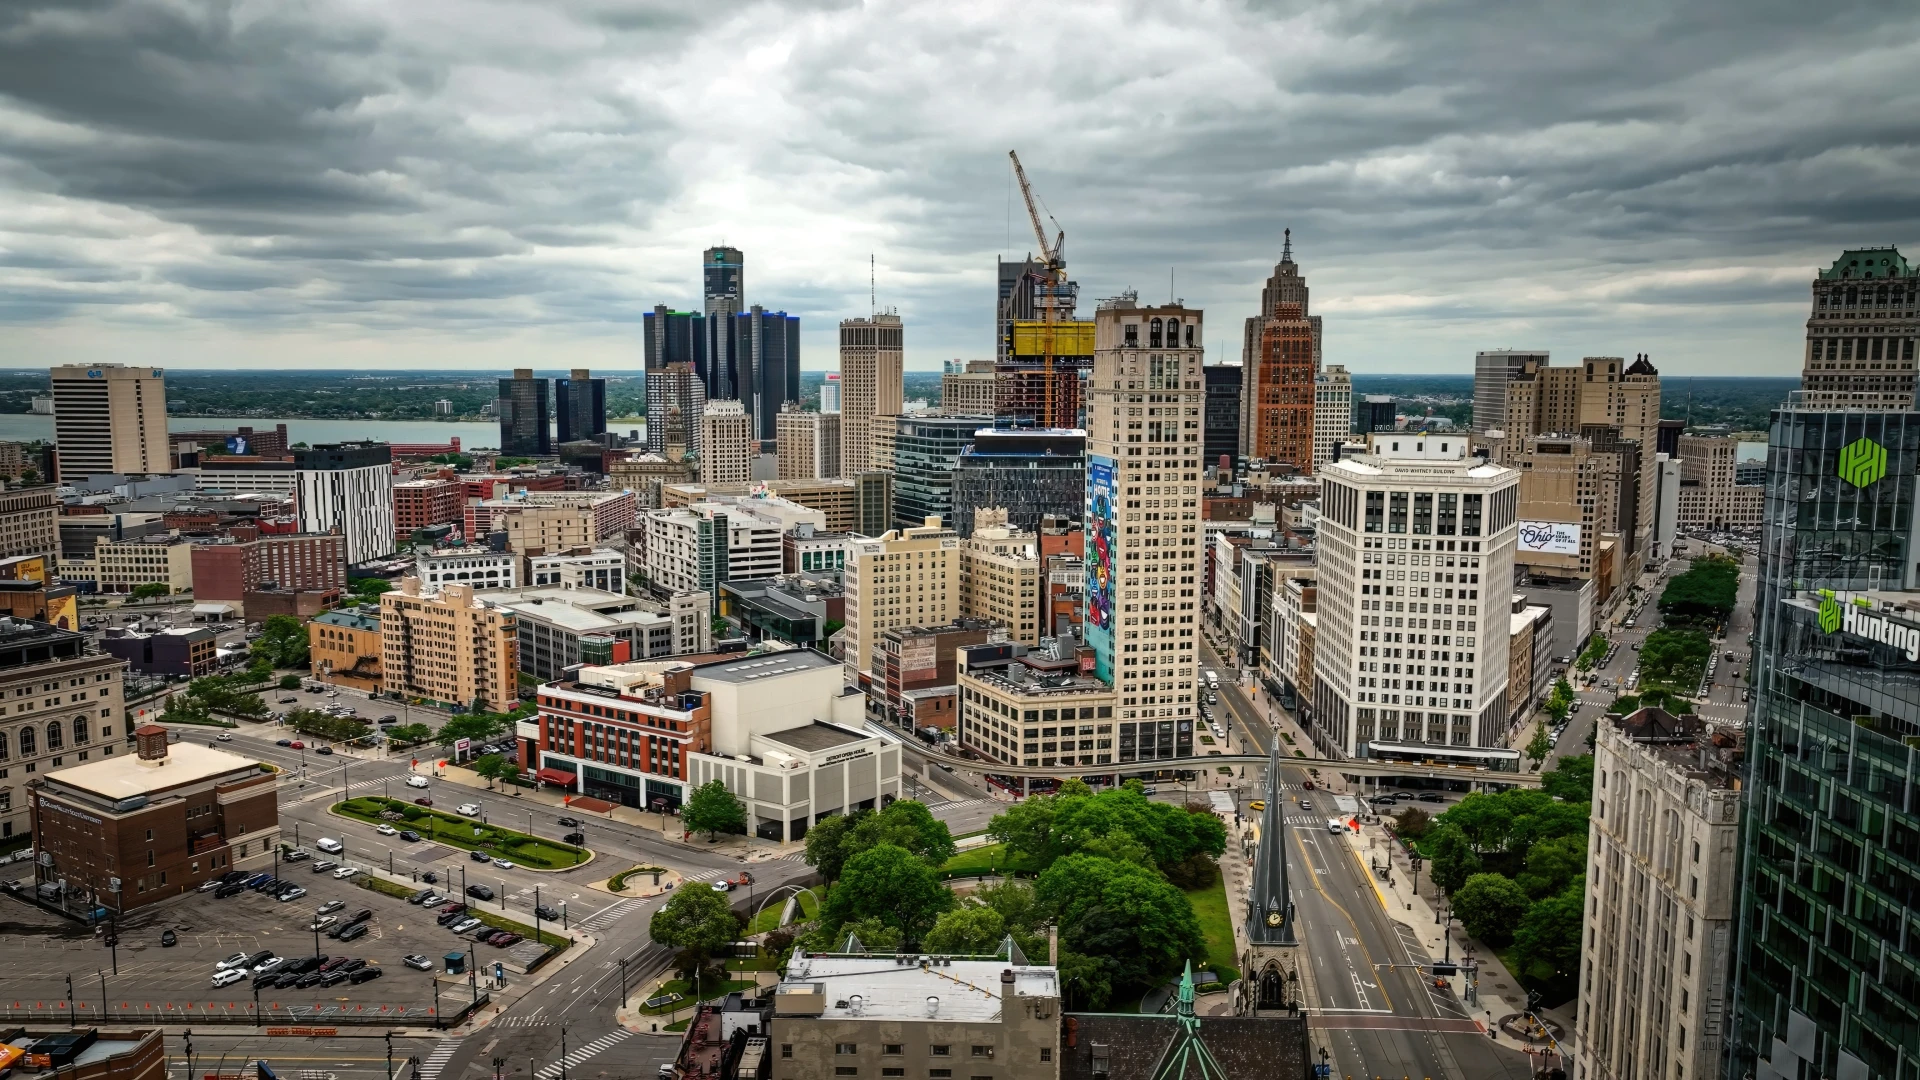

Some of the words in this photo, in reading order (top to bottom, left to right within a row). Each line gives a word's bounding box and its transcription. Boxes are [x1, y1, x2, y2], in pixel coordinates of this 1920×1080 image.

[1520, 529, 1555, 543] Ohio
[826, 753, 841, 761] DETROIT
[853, 747, 866, 755] HOUSE
